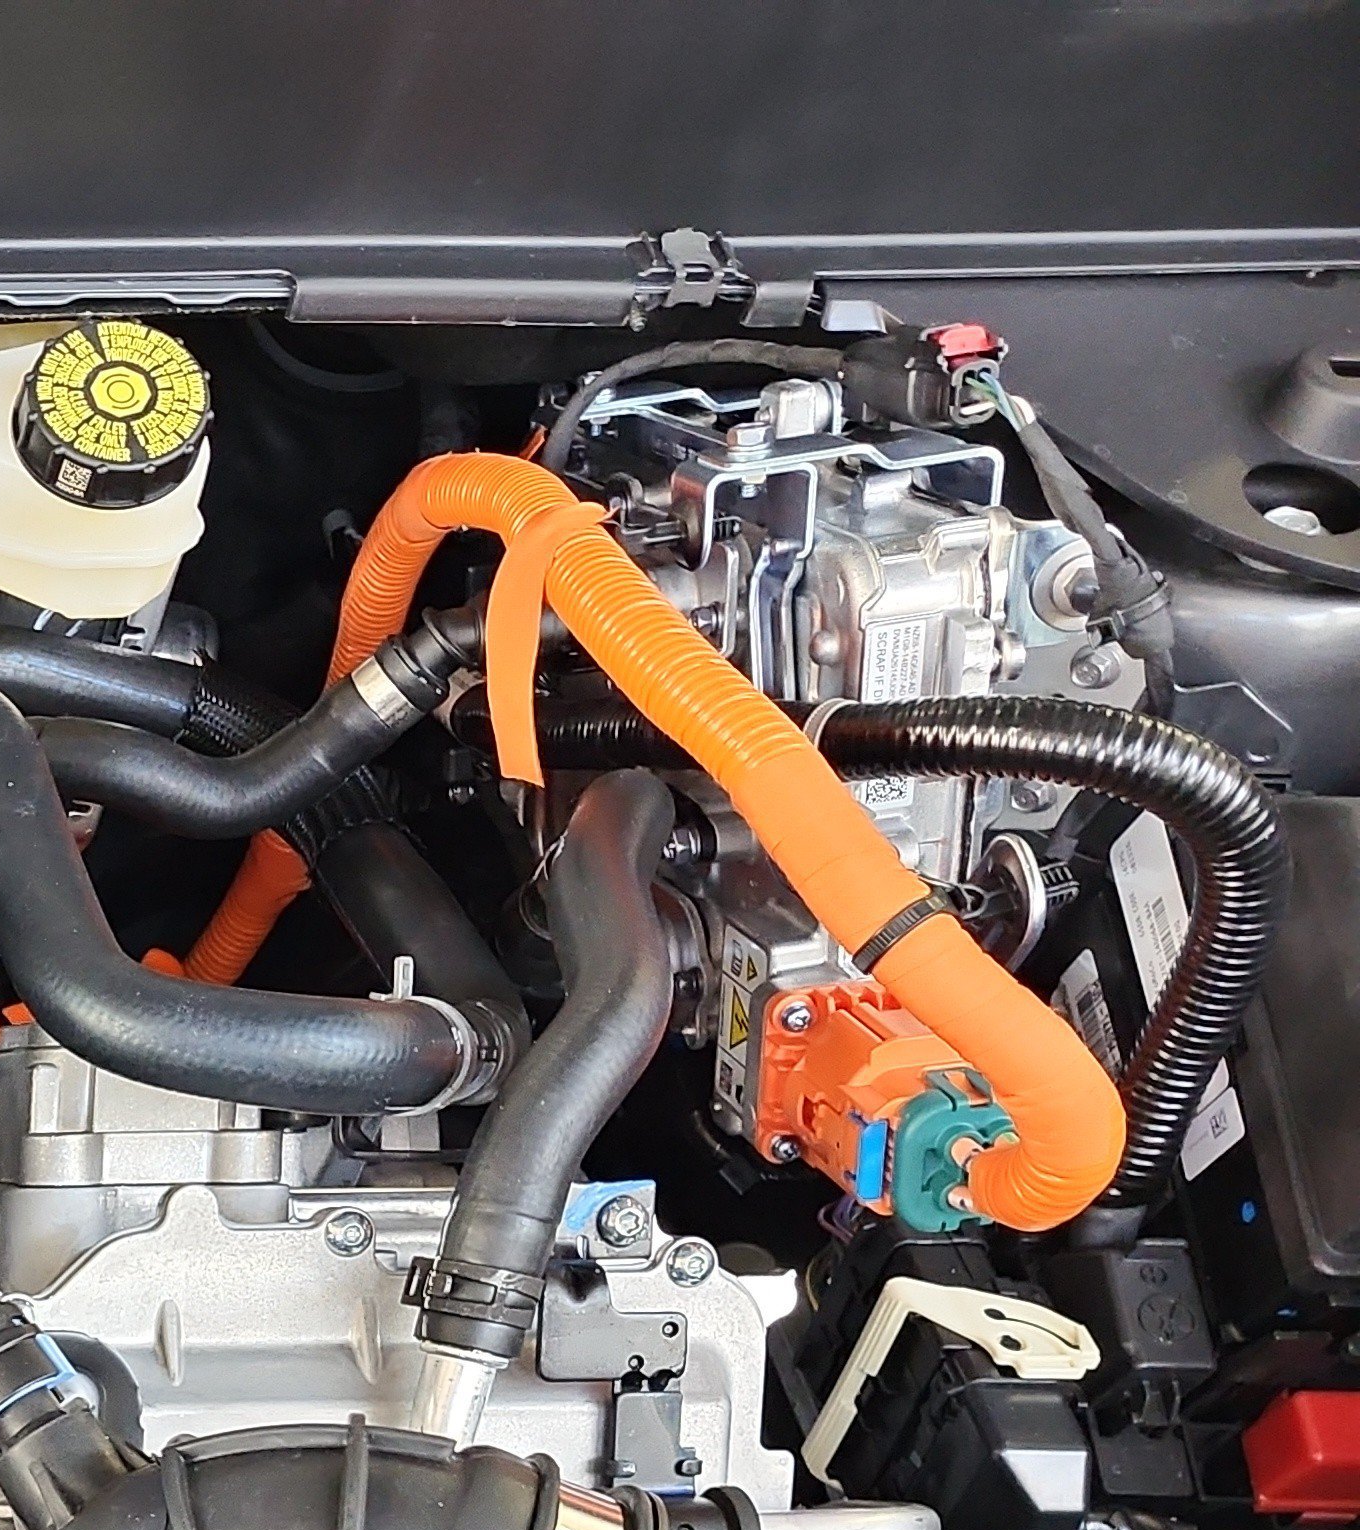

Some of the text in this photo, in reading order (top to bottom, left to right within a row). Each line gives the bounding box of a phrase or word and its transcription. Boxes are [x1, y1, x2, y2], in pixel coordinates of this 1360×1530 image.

[63, 329, 87, 349] DOT
[97, 322, 148, 340] ATTENTION
[38, 348, 65, 376] FLUID
[36, 375, 54, 402] FROM
[52, 340, 128, 448] CAP BEFORE REMOVING USE ONLY
[68, 352, 127, 436] WARNING CLEAN FILLER
[43, 410, 78, 443] SEALED
[180, 409, 202, 440] AVANT
[73, 439, 132, 463] CONTAINER
[144, 435, 184, 459] DEPOSE
[875, 632, 887, 673] SCRAP
